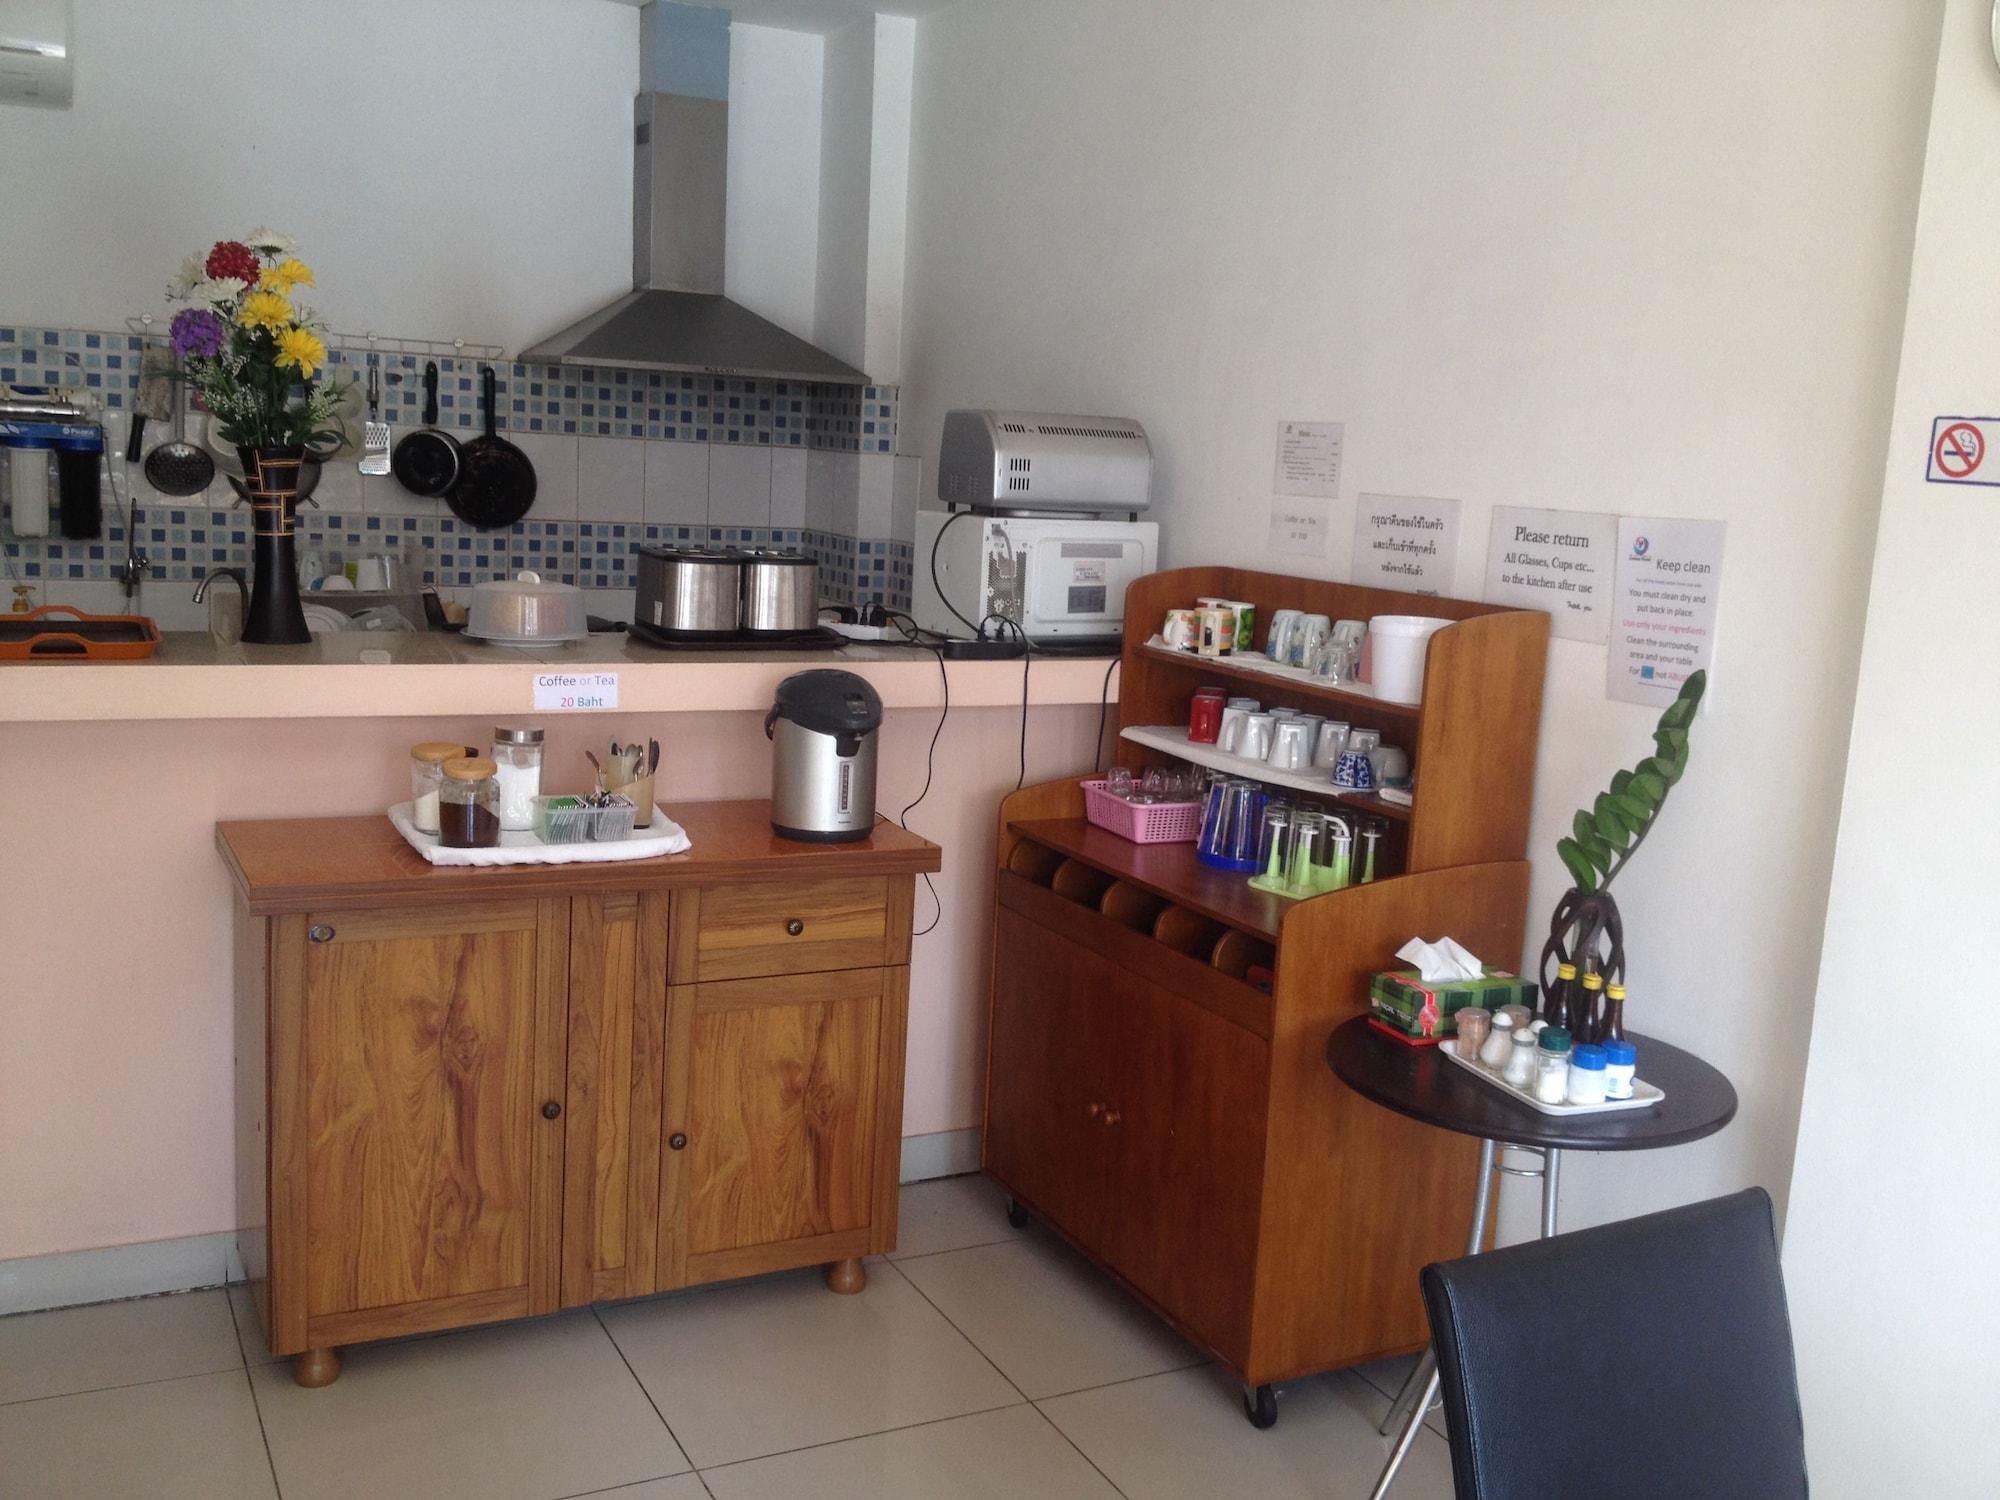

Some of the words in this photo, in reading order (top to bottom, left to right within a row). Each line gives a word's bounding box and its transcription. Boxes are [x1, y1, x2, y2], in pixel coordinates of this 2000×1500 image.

[1514, 526, 1550, 543] Please
[1553, 534, 1590, 548] return
[1504, 552, 1516, 564] All
[1518, 553, 1549, 568] Glasses,
[1551, 557, 1573, 573] Cups
[1656, 559, 1681, 573] Keep
[1683, 560, 1711, 574] clean
[1502, 573, 1511, 582] to
[1512, 573, 1525, 585] the
[1526, 575, 1556, 589] kitchen
[1557, 579, 1577, 592] after
[1578, 584, 1593, 594] use
[1629, 588, 1642, 597] You
[1643, 590, 1660, 599] must
[1661, 592, 1678, 601] clean
[1680, 593, 1691, 603] dry
[1692, 595, 1707, 604] and
[1637, 605, 1648, 613] put
[1649, 605, 1665, 614] back
[1667, 607, 1673, 615] in
[1636, 620, 1650, 630] only
[1651, 623, 1667, 633] your
[1668, 624, 1706, 636] ingredients
[1626, 635, 1645, 645] Clean
[1646, 637, 1657, 646] the
[1658, 640, 1699, 654] surrounding
[1629, 651, 1644, 659] area
[1645, 652, 1658, 661] and
[1659, 655, 1675, 665] your
[1675, 657, 1694, 666] table
[1629, 666, 1640, 675] For
[1655, 670, 1667, 679] not
[539, 675, 577, 687] Coffee
[579, 677, 591, 686] or
[594, 675, 615, 686] Tea
[560, 696, 575, 708] 20
[577, 696, 604, 707] Baht
